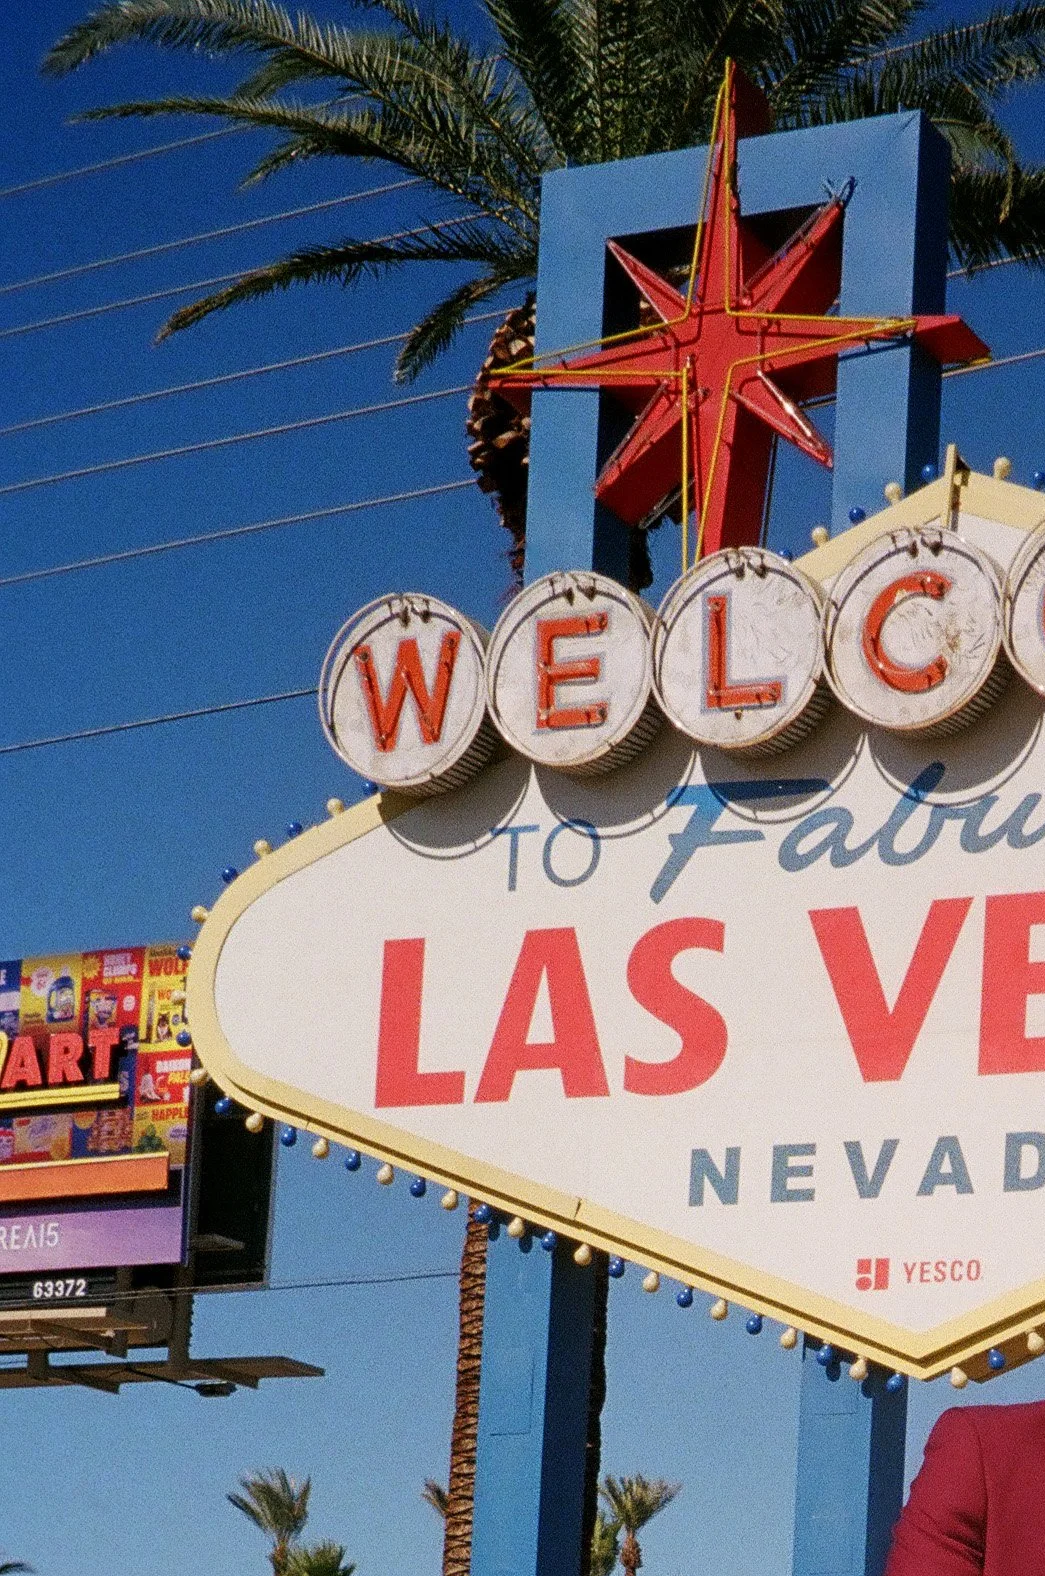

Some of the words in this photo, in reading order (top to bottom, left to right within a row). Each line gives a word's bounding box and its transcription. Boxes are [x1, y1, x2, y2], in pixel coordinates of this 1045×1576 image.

[491, 817, 602, 892] TO
[374, 916, 729, 1109] LAS
[0, 1027, 121, 1089] ART
[32, 1278, 87, 1298] 63372
[903, 1259, 981, 1284] YESCO
